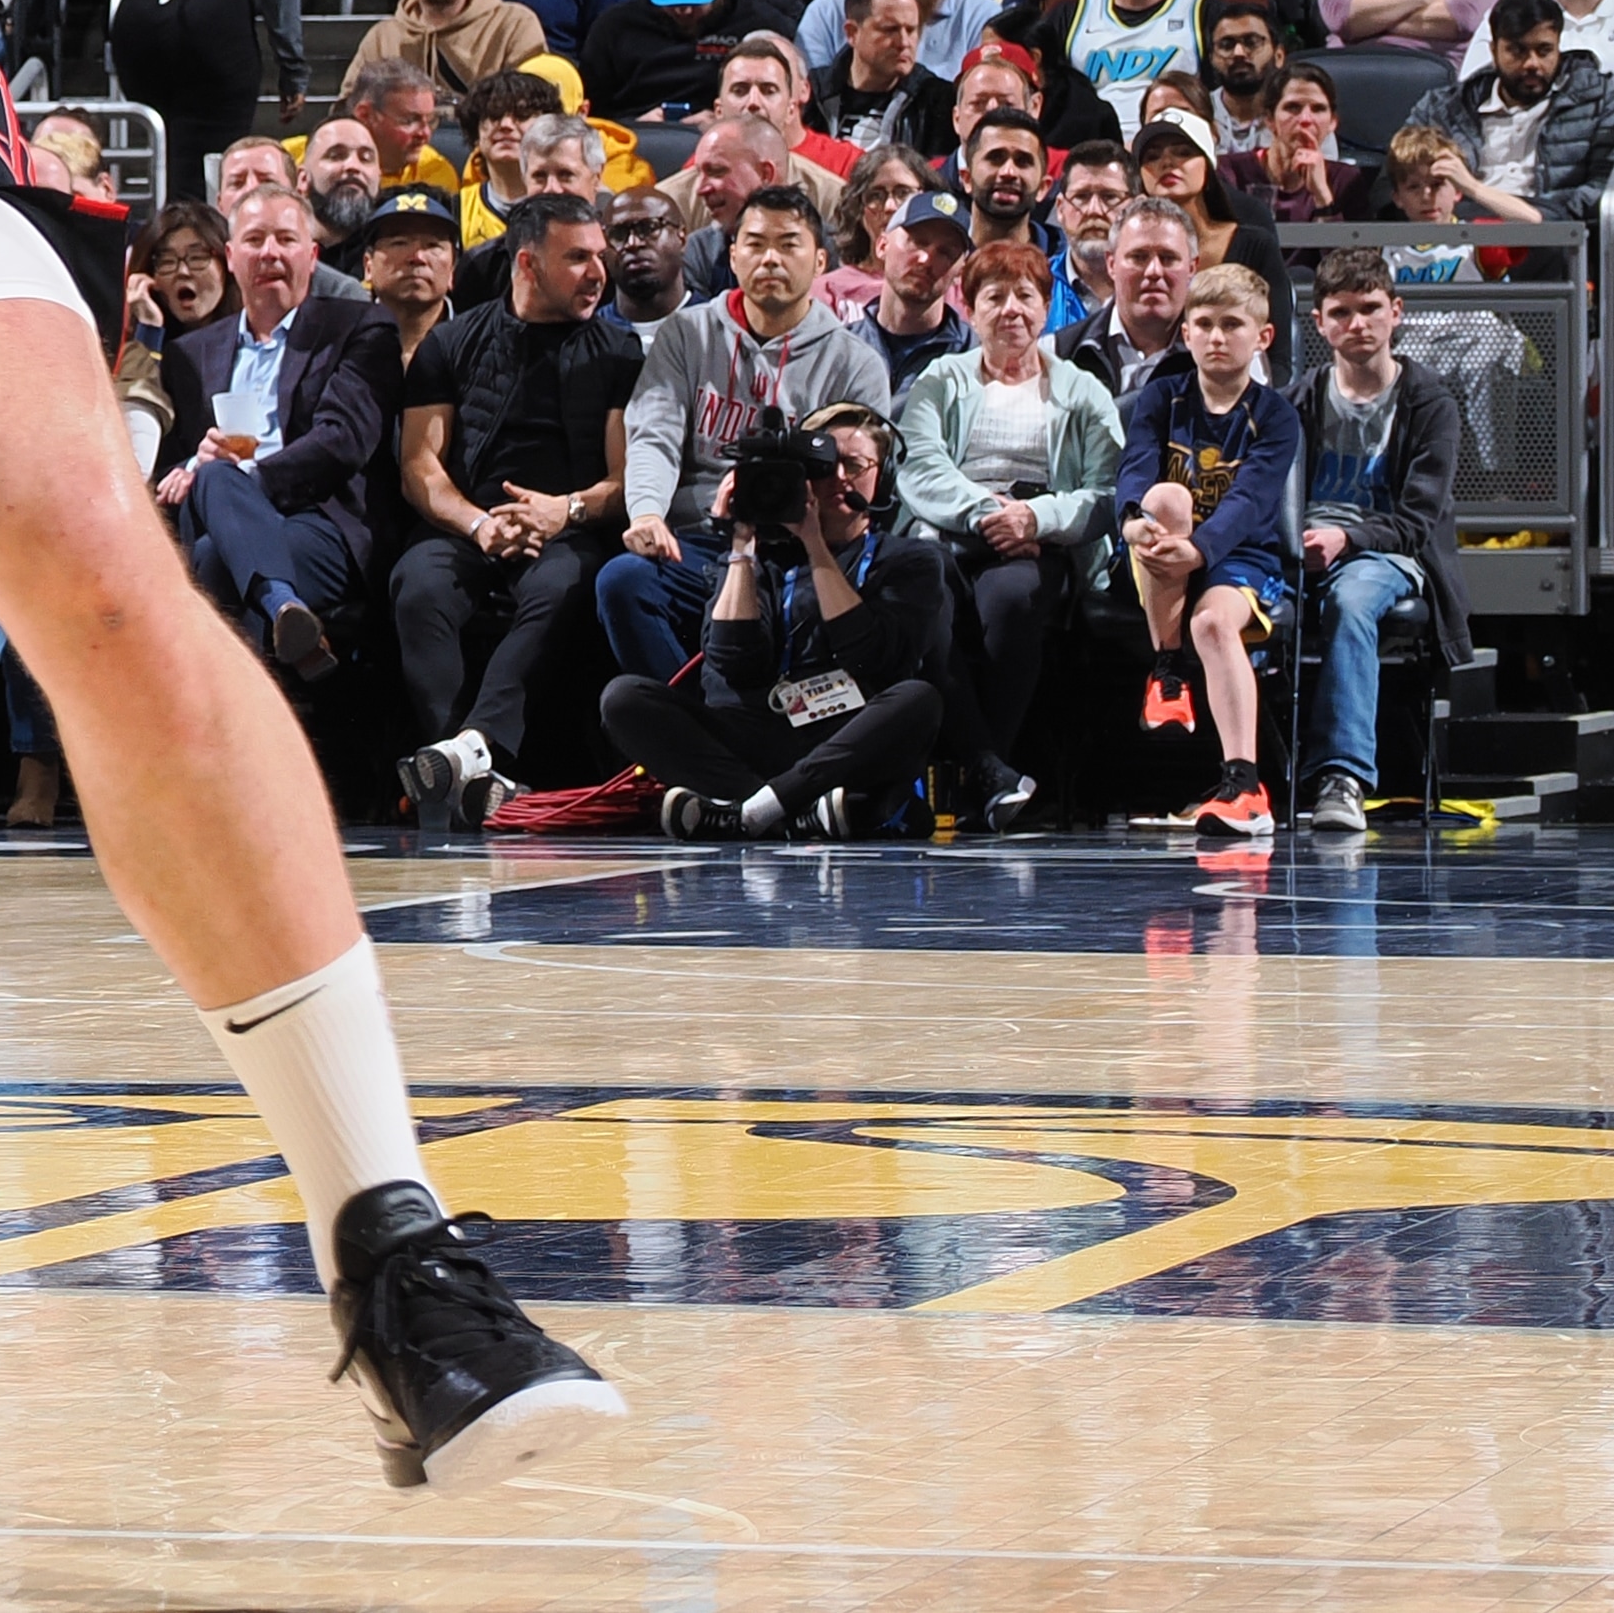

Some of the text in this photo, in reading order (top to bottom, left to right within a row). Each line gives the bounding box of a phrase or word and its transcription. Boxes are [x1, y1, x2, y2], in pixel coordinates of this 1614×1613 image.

[1083, 45, 1179, 83] INDY
[396, 193, 429, 212] M
[693, 388, 759, 447] INDI
